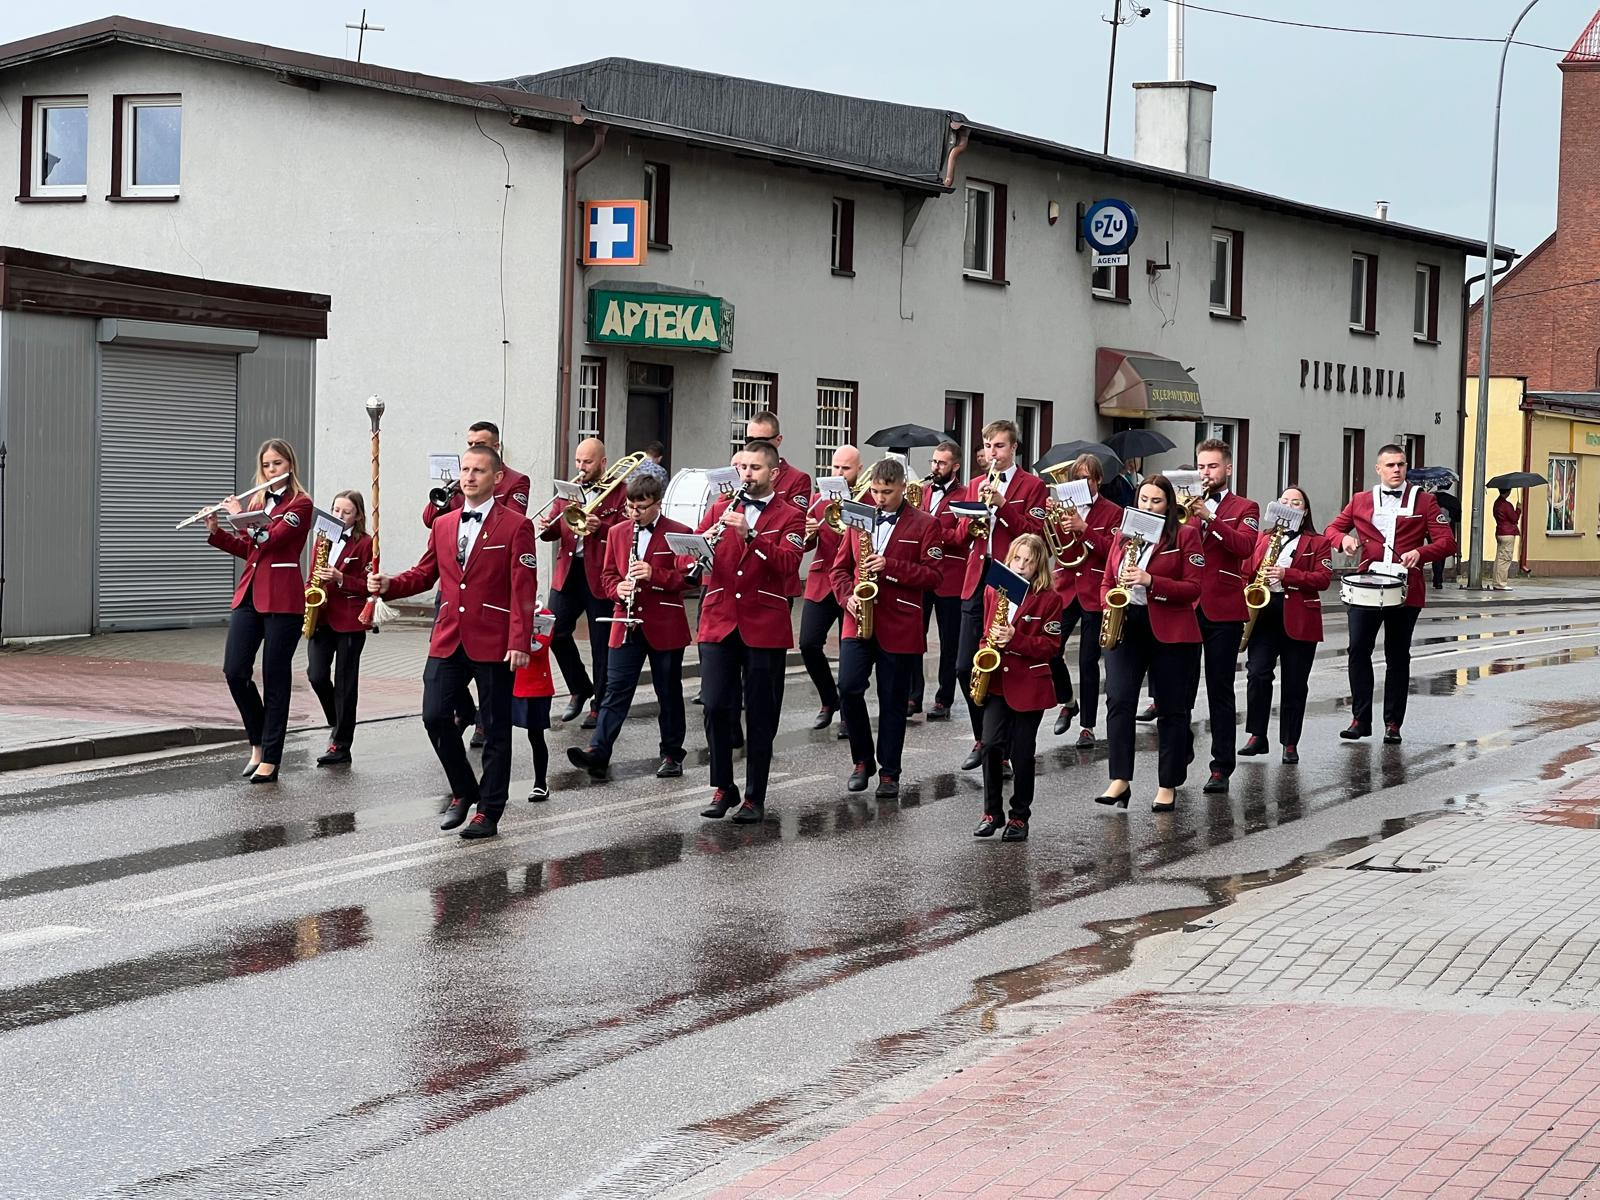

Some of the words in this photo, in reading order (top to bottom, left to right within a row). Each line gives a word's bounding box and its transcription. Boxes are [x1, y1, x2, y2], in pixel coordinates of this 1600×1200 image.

[1095, 214, 1123, 238] PZU
[1097, 256, 1121, 264] AGENT
[600, 300, 718, 341] APTEKA
[1300, 359, 1405, 399] PIEKARNIA
